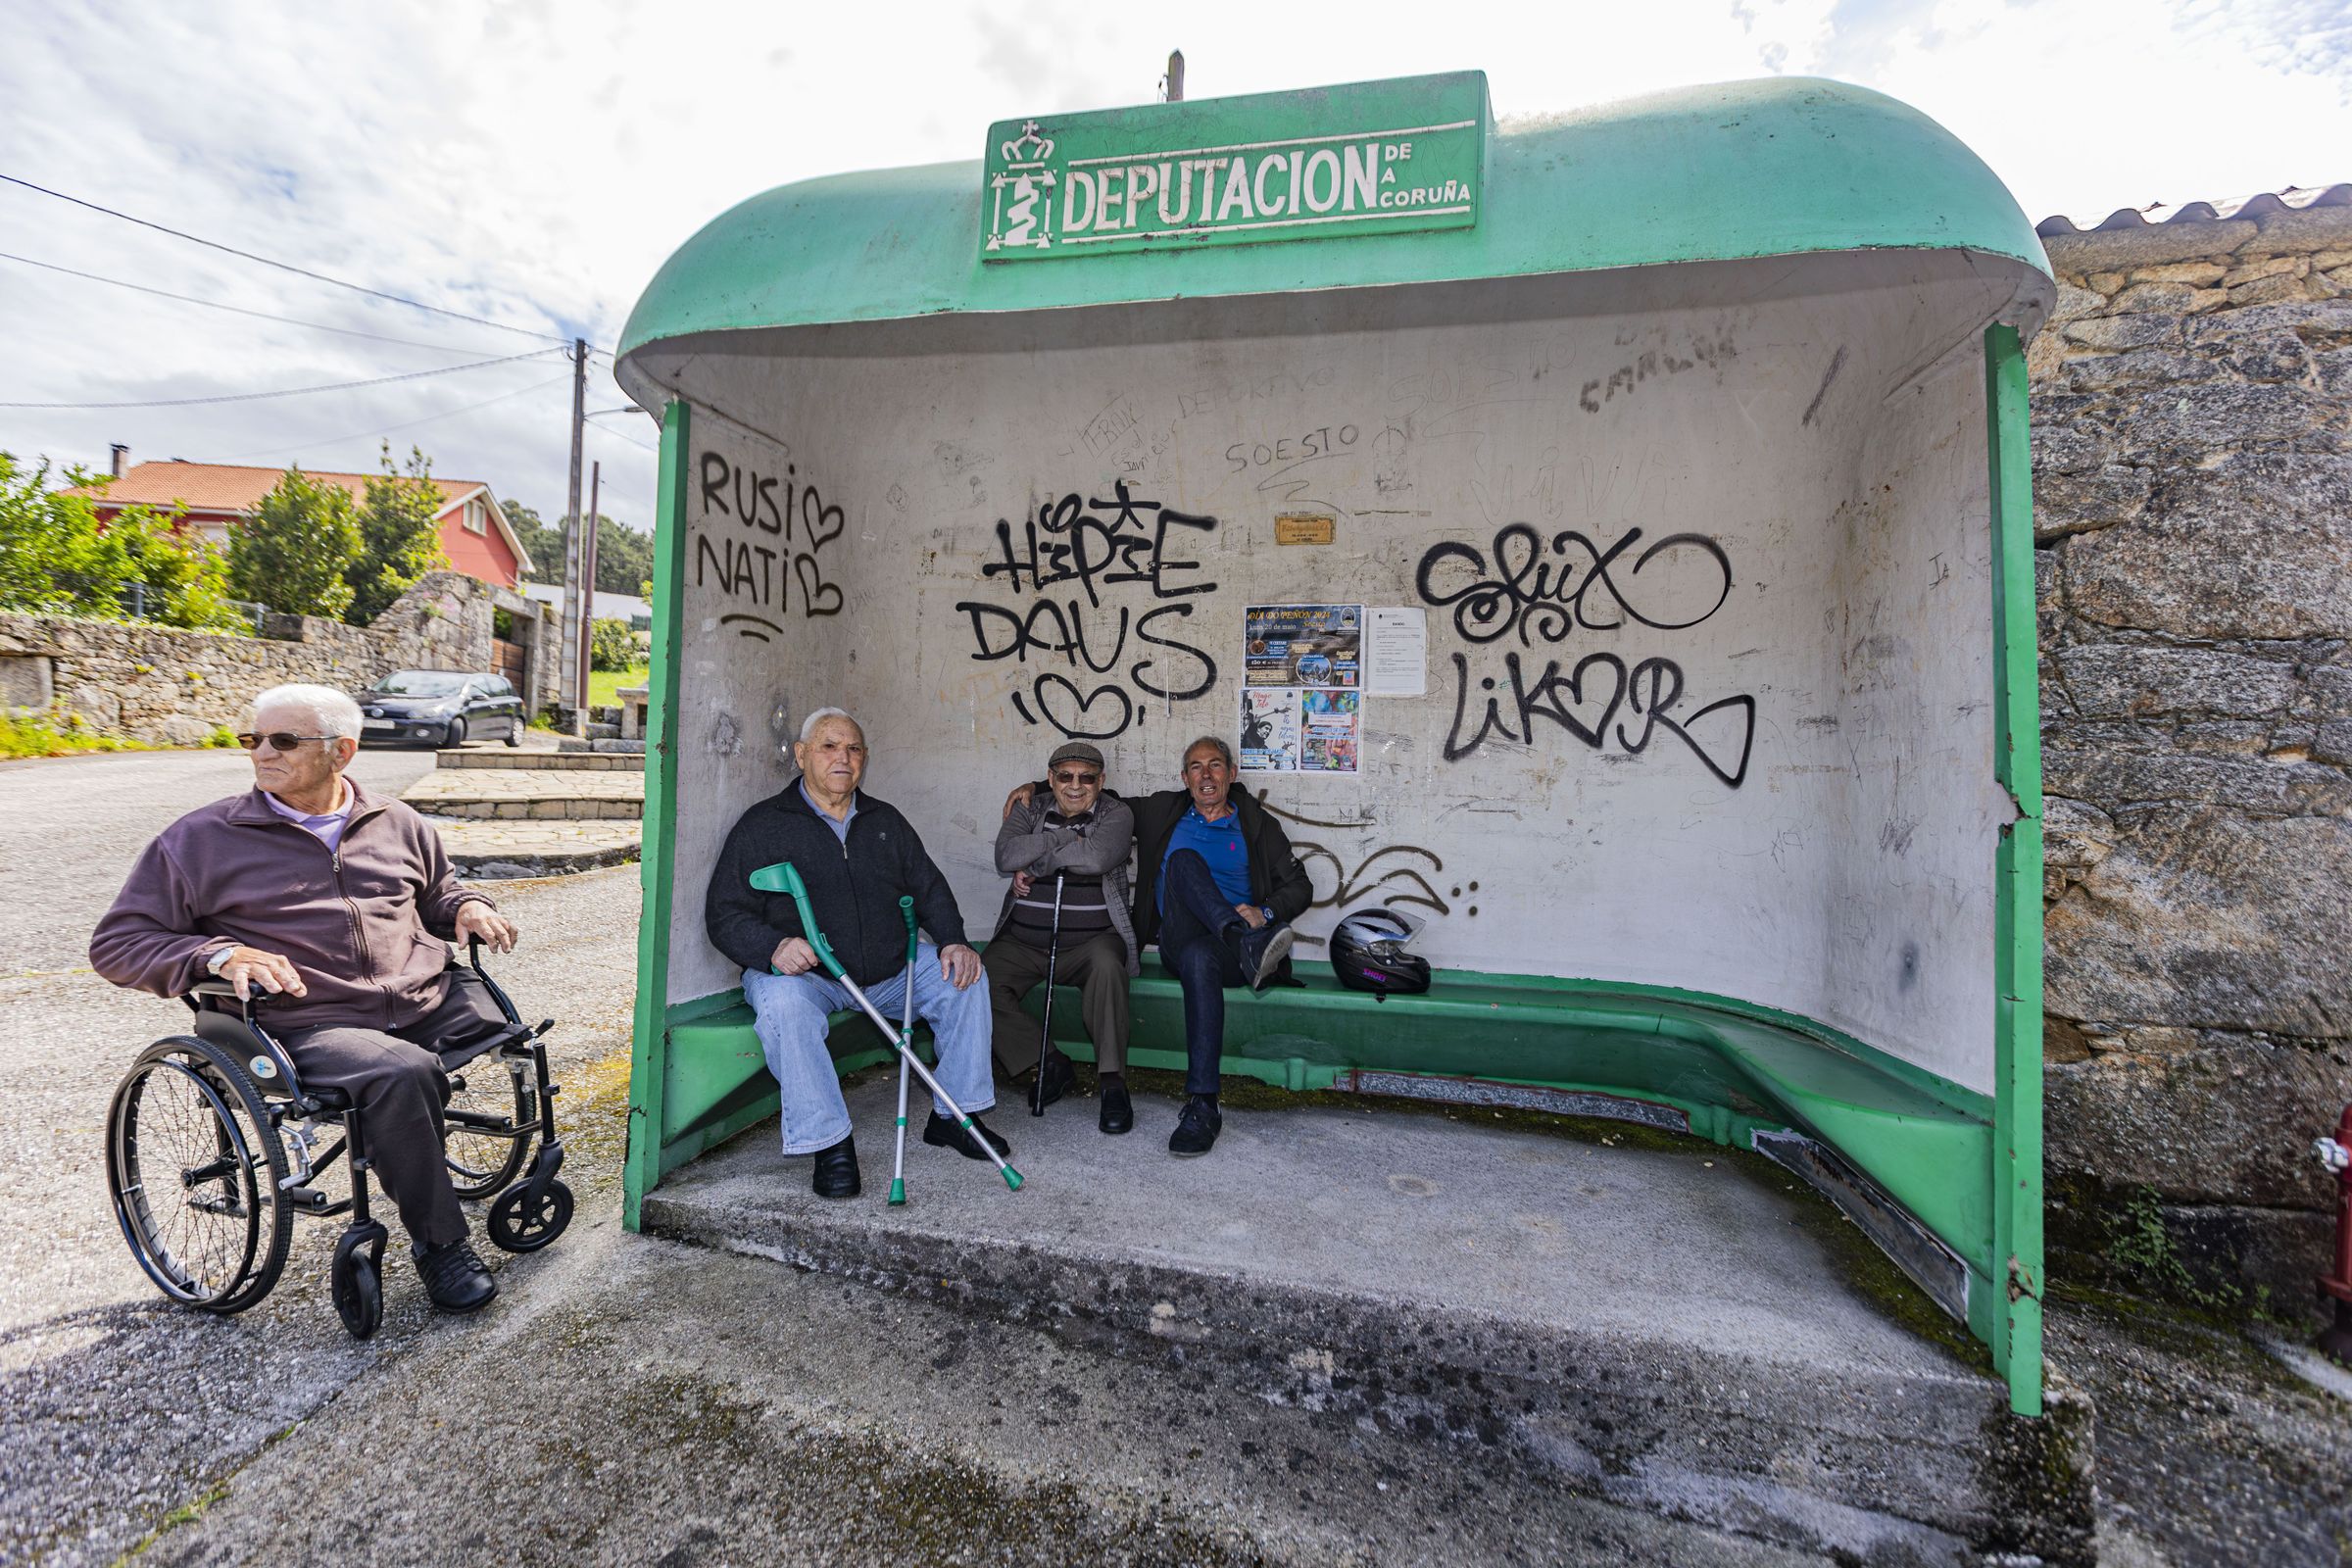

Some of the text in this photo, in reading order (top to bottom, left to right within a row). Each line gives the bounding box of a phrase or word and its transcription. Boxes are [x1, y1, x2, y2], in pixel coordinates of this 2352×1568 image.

[1385, 142, 1412, 162] DE
[1061, 142, 1380, 233] DEPUTACION
[1380, 167, 1396, 184] A
[1380, 179, 1471, 209] CORUÑA
[1225, 423, 1360, 473] SOESTO
[1362, 967, 1388, 983] SHOEI
